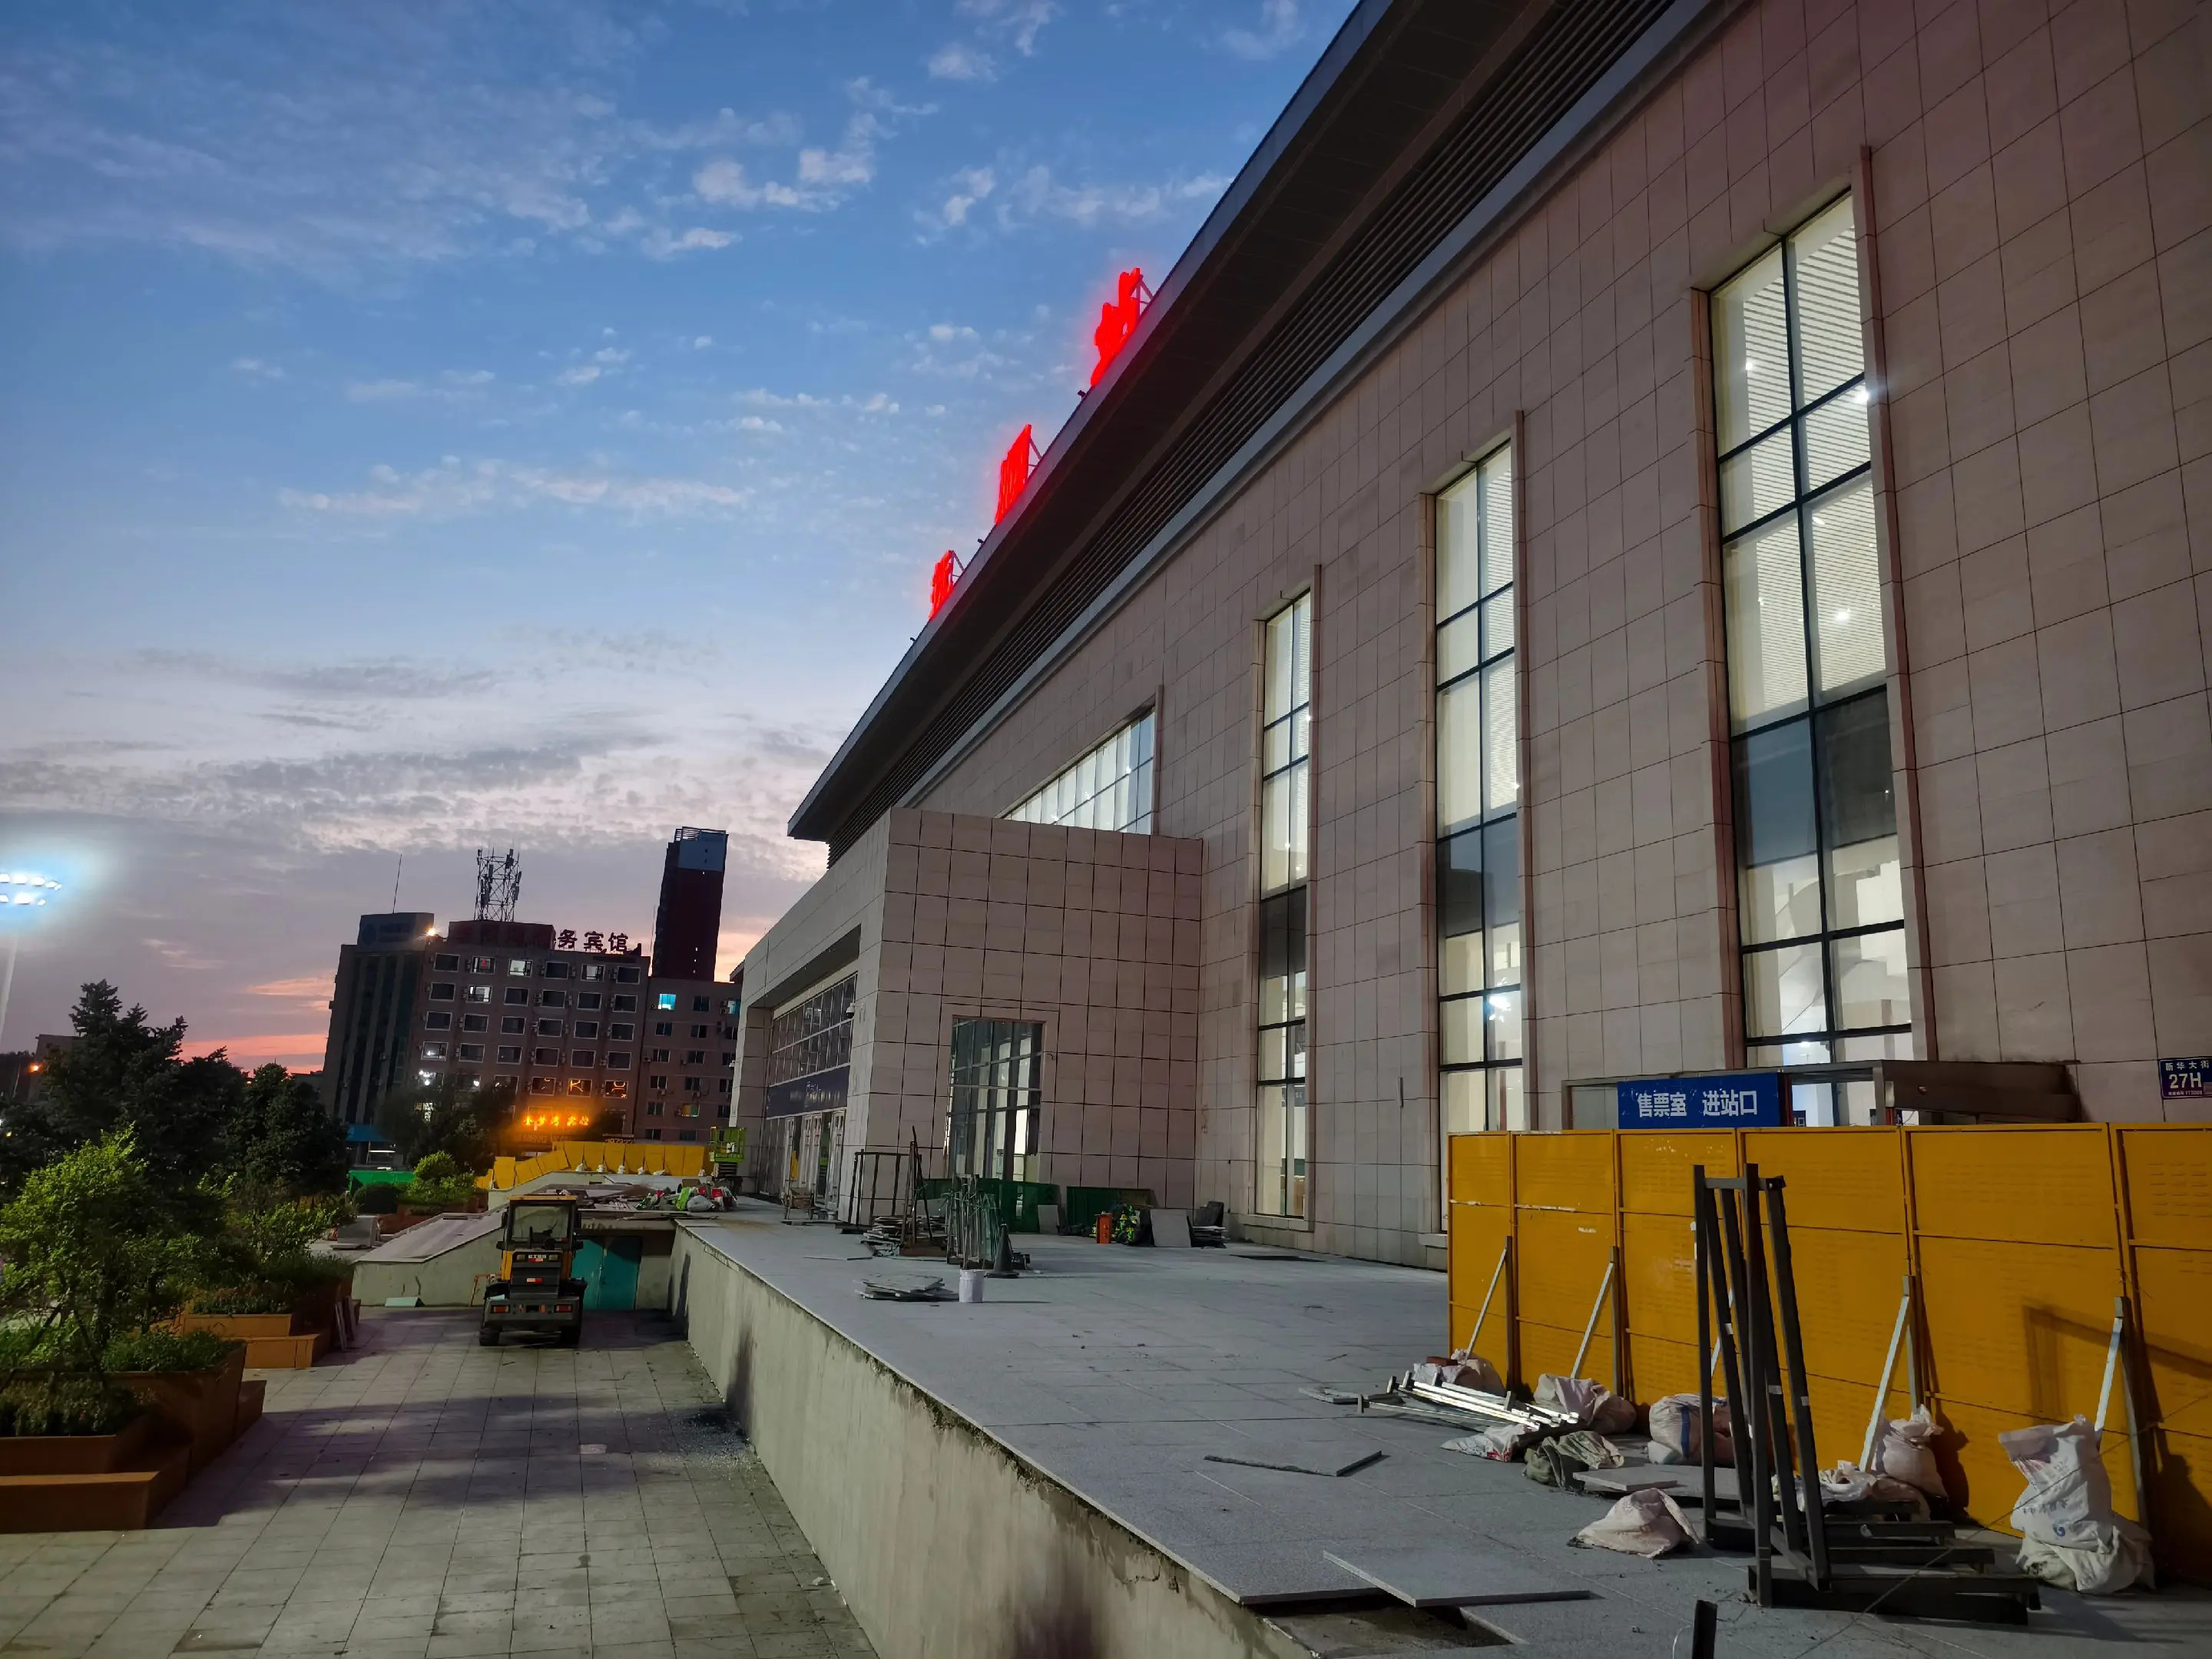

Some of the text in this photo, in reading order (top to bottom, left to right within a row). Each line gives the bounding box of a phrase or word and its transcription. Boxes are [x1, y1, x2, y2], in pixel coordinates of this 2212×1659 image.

[553, 929, 628, 952] 务宾馆
[2168, 1071, 2202, 1089] 27H
[1637, 1089, 1757, 1118] 售票室 进站口
